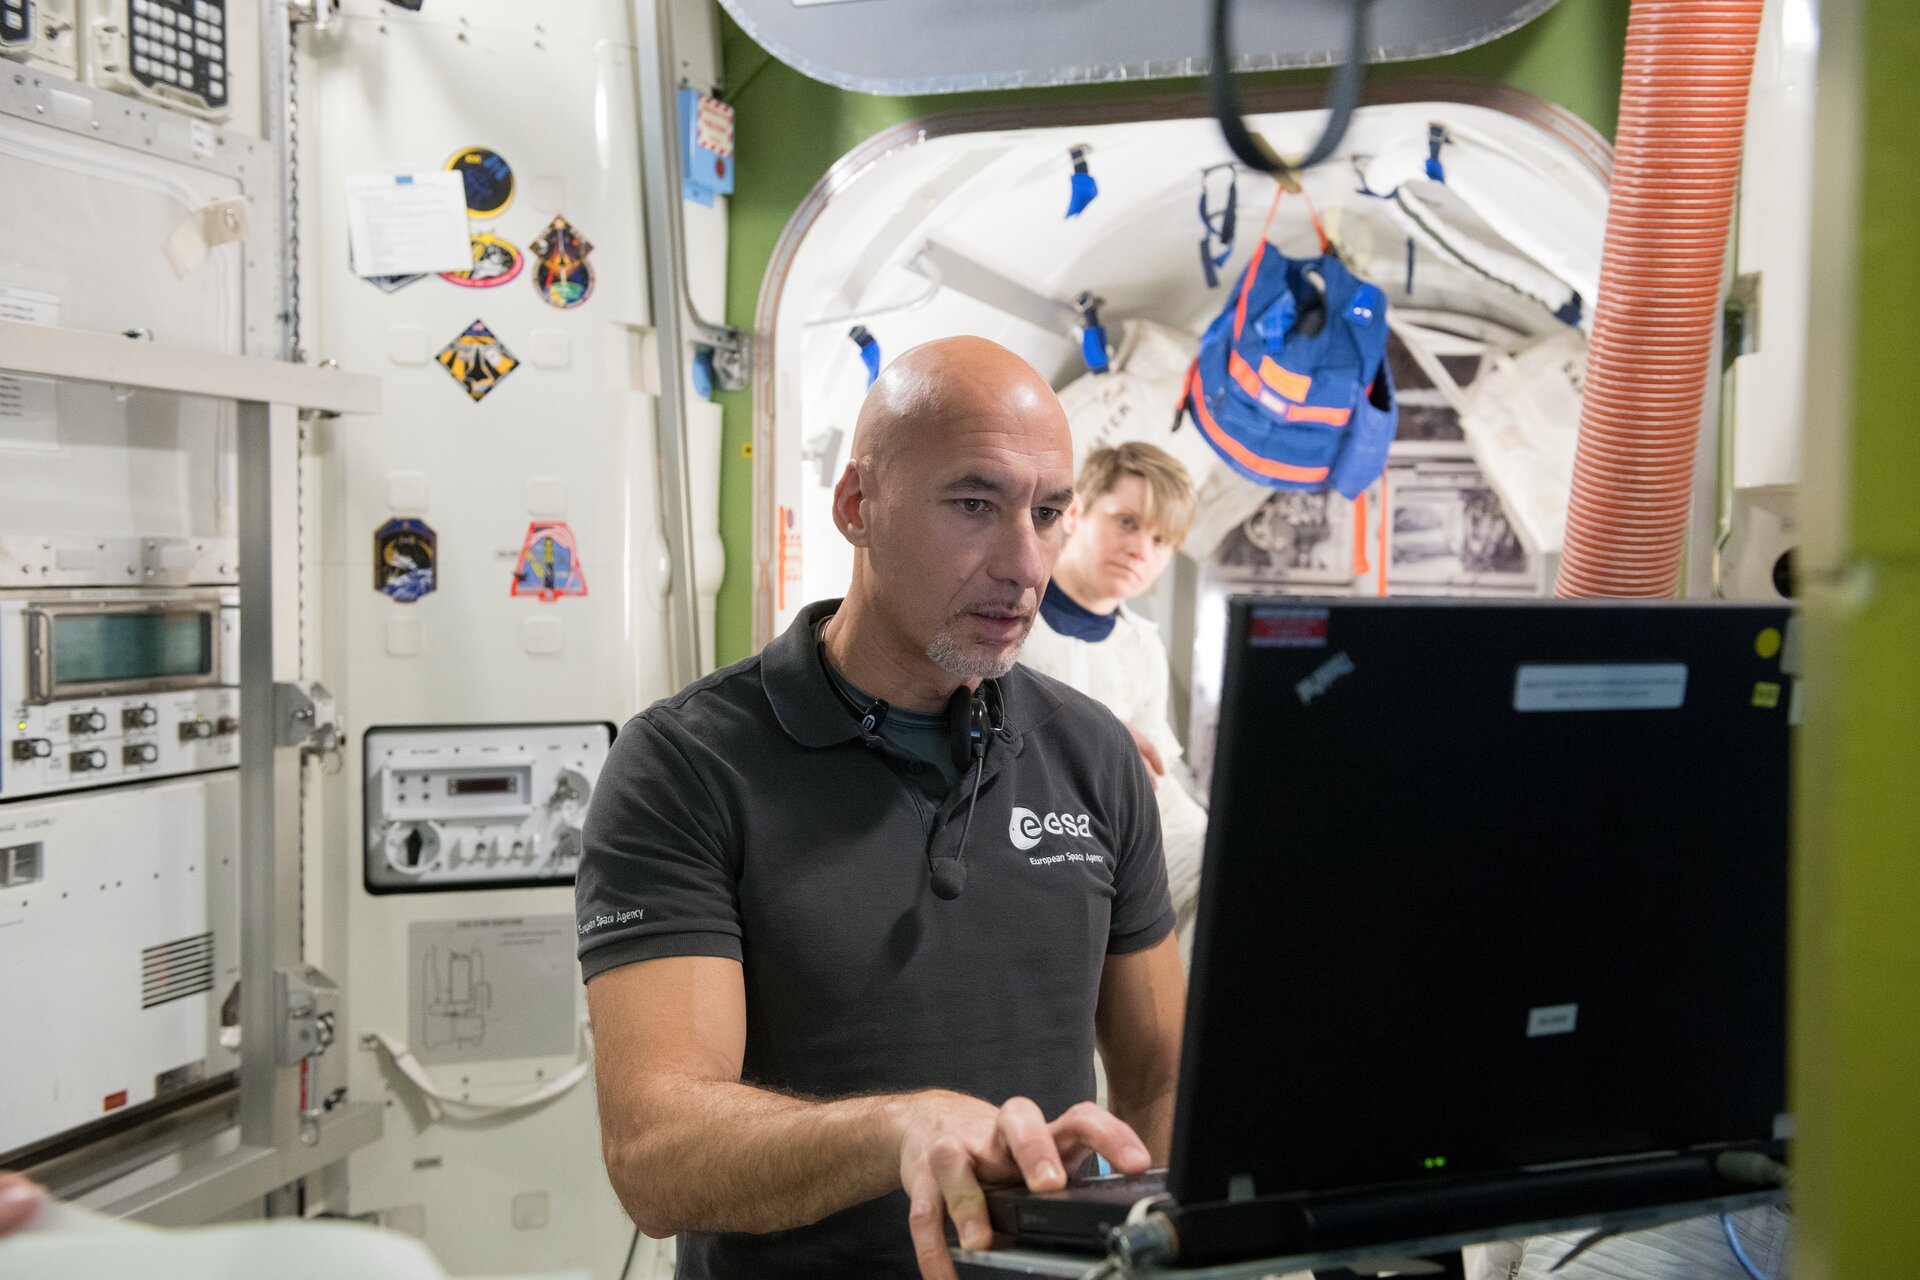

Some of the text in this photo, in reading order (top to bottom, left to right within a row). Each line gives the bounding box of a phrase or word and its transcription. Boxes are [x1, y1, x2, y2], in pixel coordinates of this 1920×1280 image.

[1029, 854, 1065, 866] European
[1065, 851, 1084, 862] Space
[596, 915, 614, 927] Space
[616, 909, 644, 923] Agency
